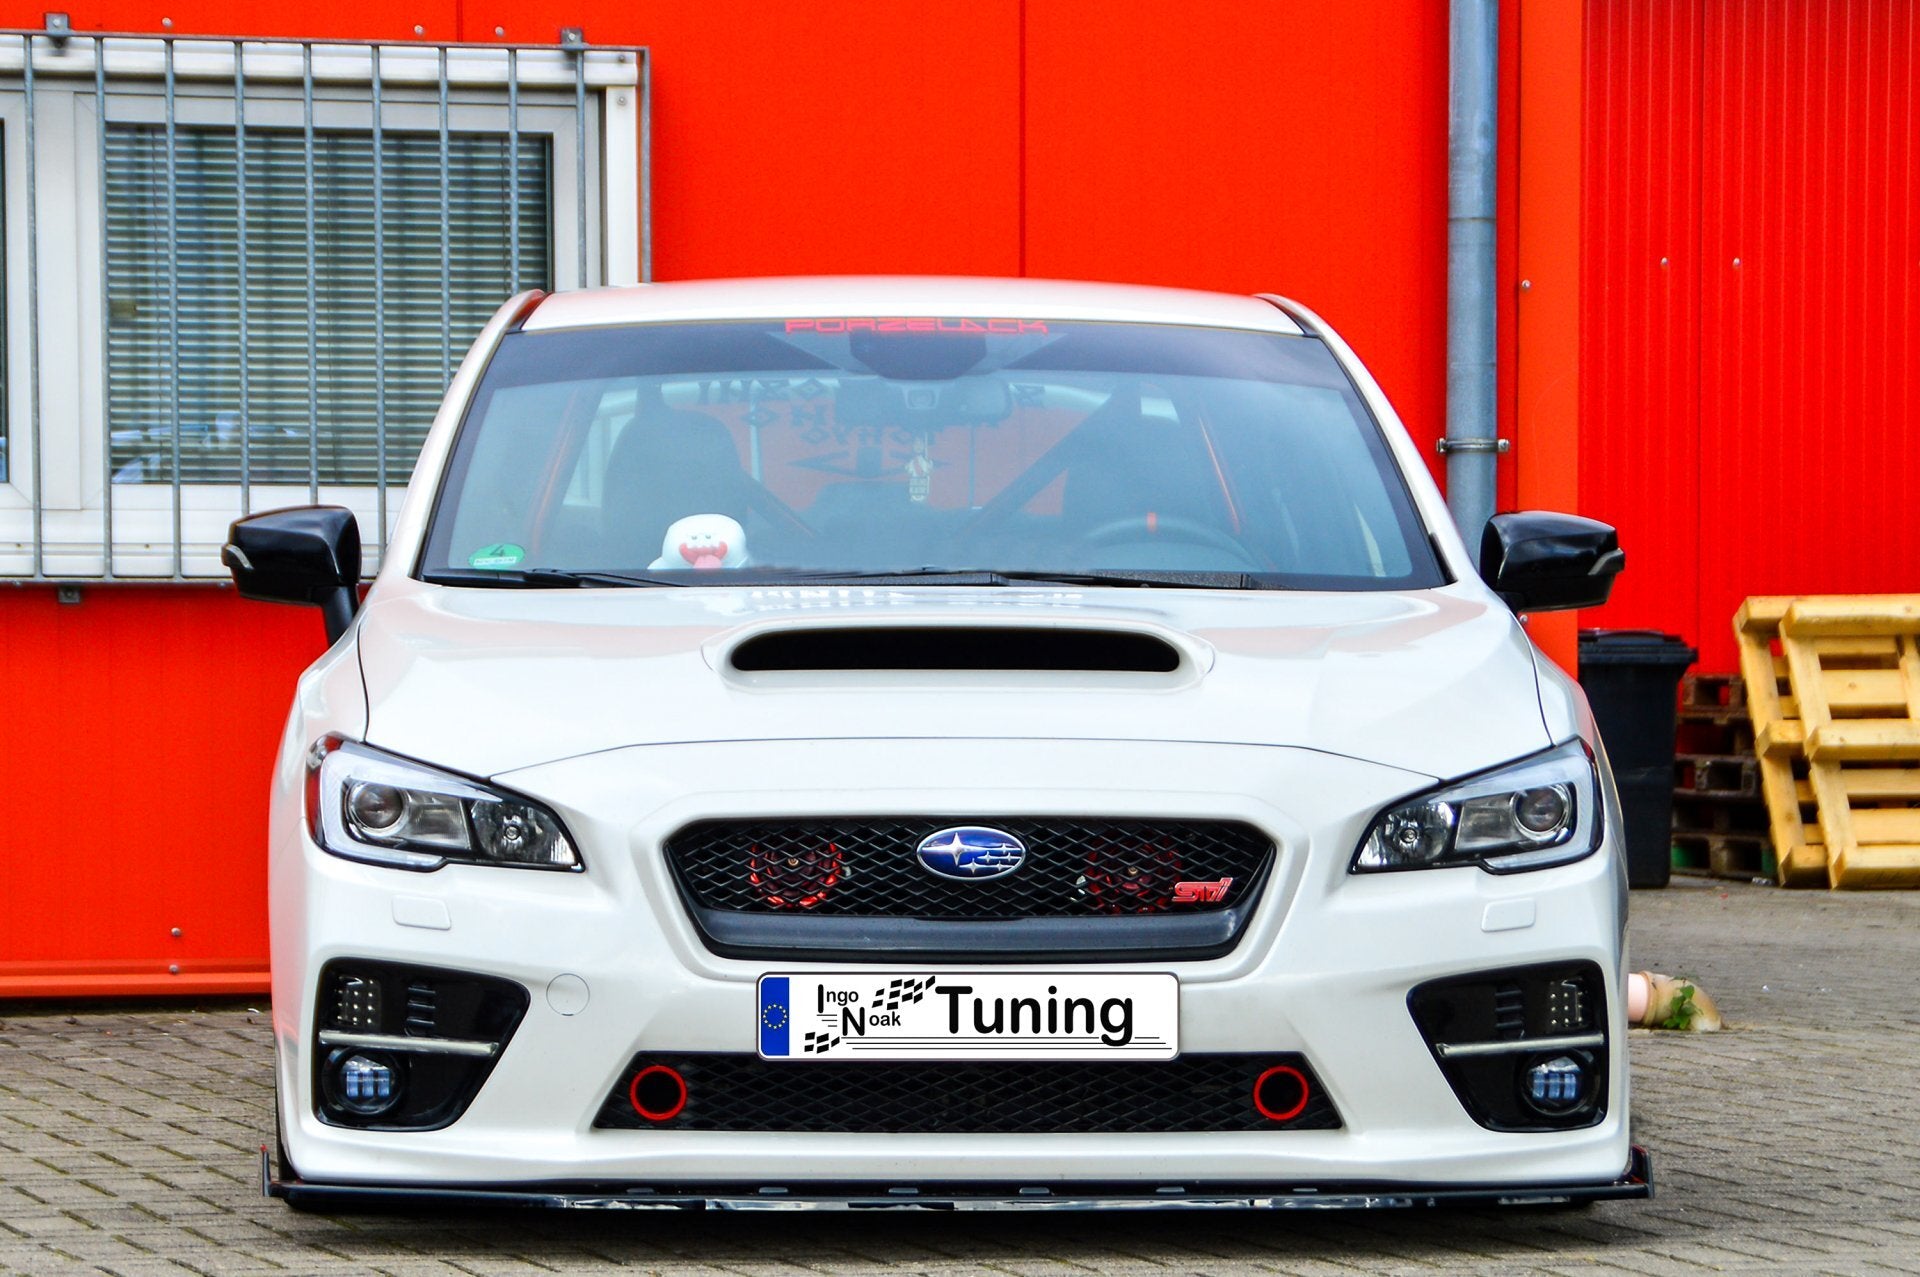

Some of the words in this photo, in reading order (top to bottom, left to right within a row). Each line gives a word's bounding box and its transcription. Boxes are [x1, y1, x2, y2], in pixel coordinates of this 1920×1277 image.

[490, 544, 506, 556] 4
[818, 984, 859, 1013] Ingo
[842, 1007, 901, 1036] Noak
[935, 986, 1133, 1047] Tuning
